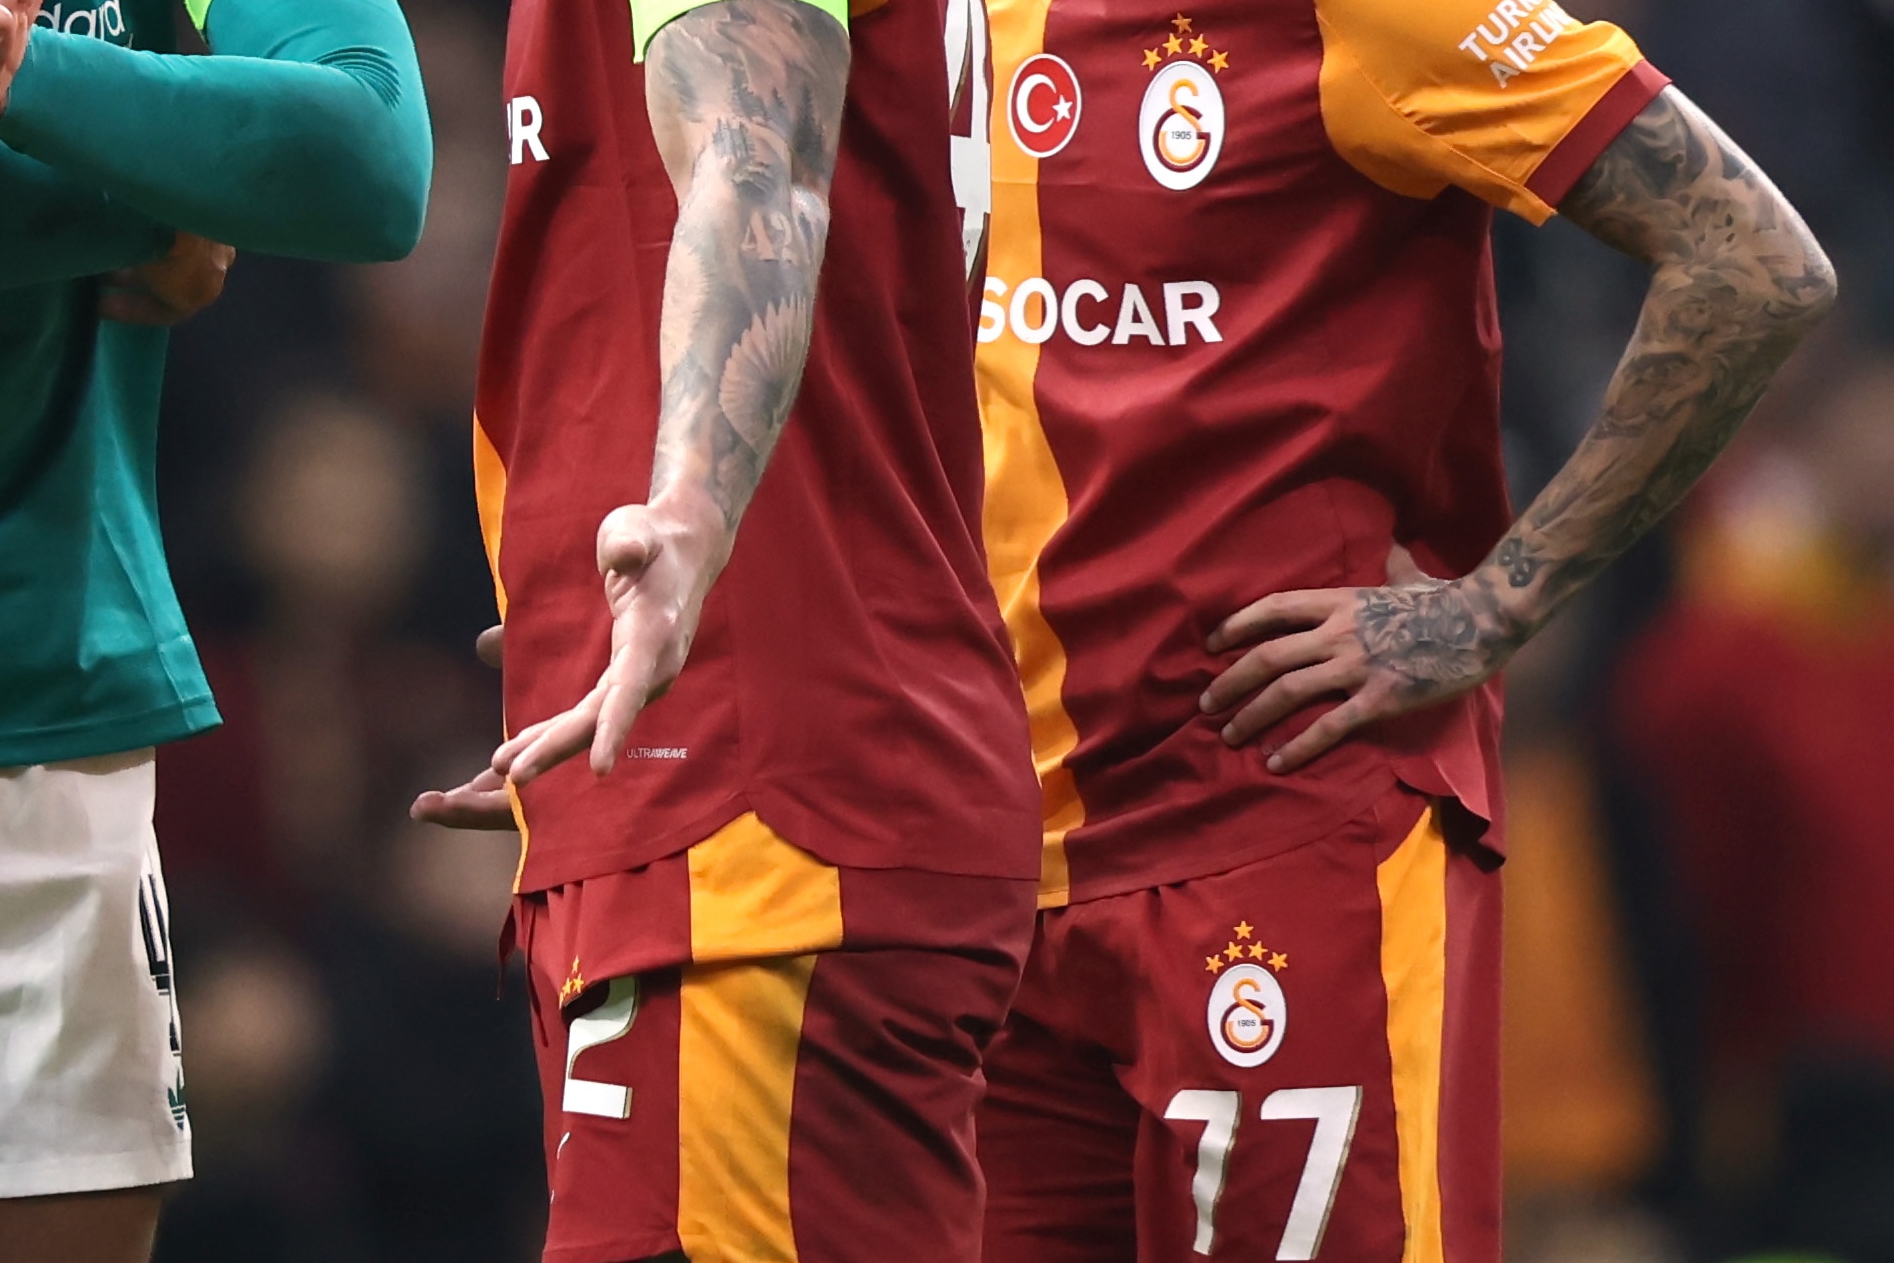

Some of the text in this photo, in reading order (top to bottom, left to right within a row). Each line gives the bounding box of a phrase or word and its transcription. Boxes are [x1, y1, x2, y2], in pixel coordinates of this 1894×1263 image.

[977, 276, 1223, 346] SOCAR
[626, 747, 688, 759] ULTRAWEAVE
[1163, 1085, 1363, 1262] 77
